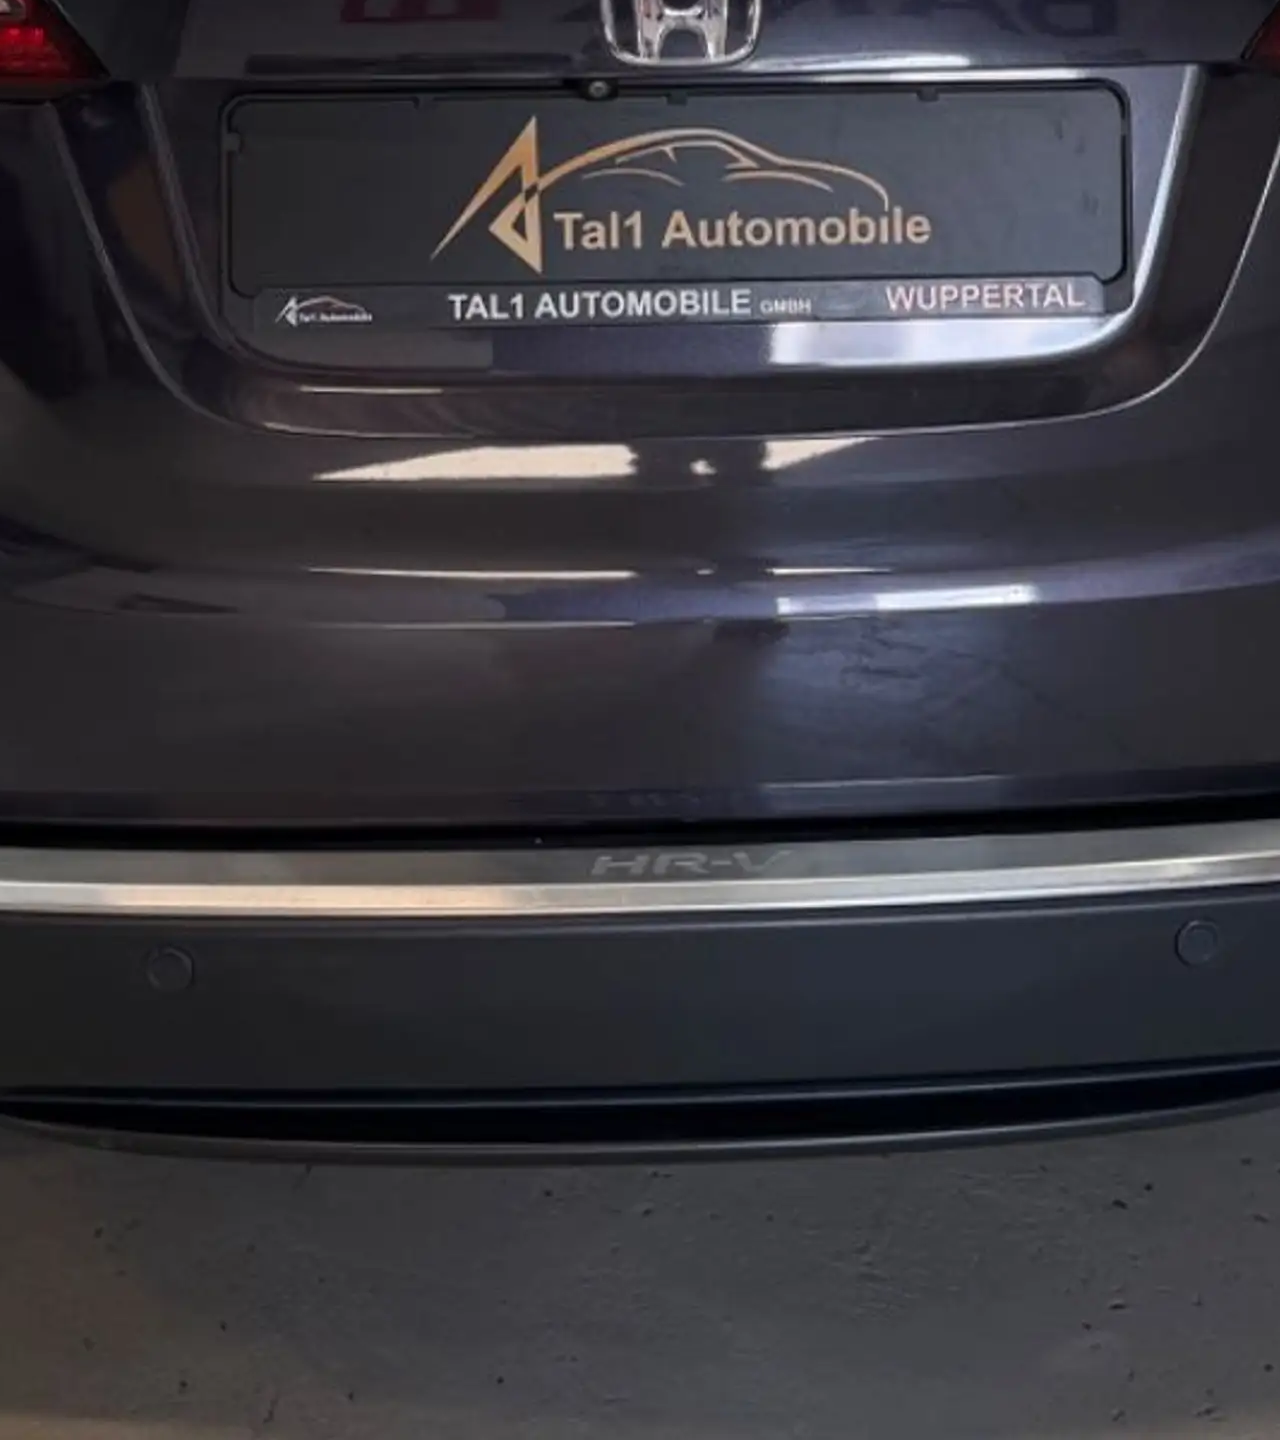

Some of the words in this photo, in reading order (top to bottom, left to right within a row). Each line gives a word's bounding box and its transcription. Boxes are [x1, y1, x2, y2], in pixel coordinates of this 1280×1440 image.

[553, 211, 643, 251] Tal1
[661, 206, 932, 249] Automobile
[448, 293, 524, 321] TAL1
[534, 288, 752, 319] AUTOMOBILE
[884, 281, 1086, 311] WUPPERTAL
[590, 849, 794, 876] HR-V
